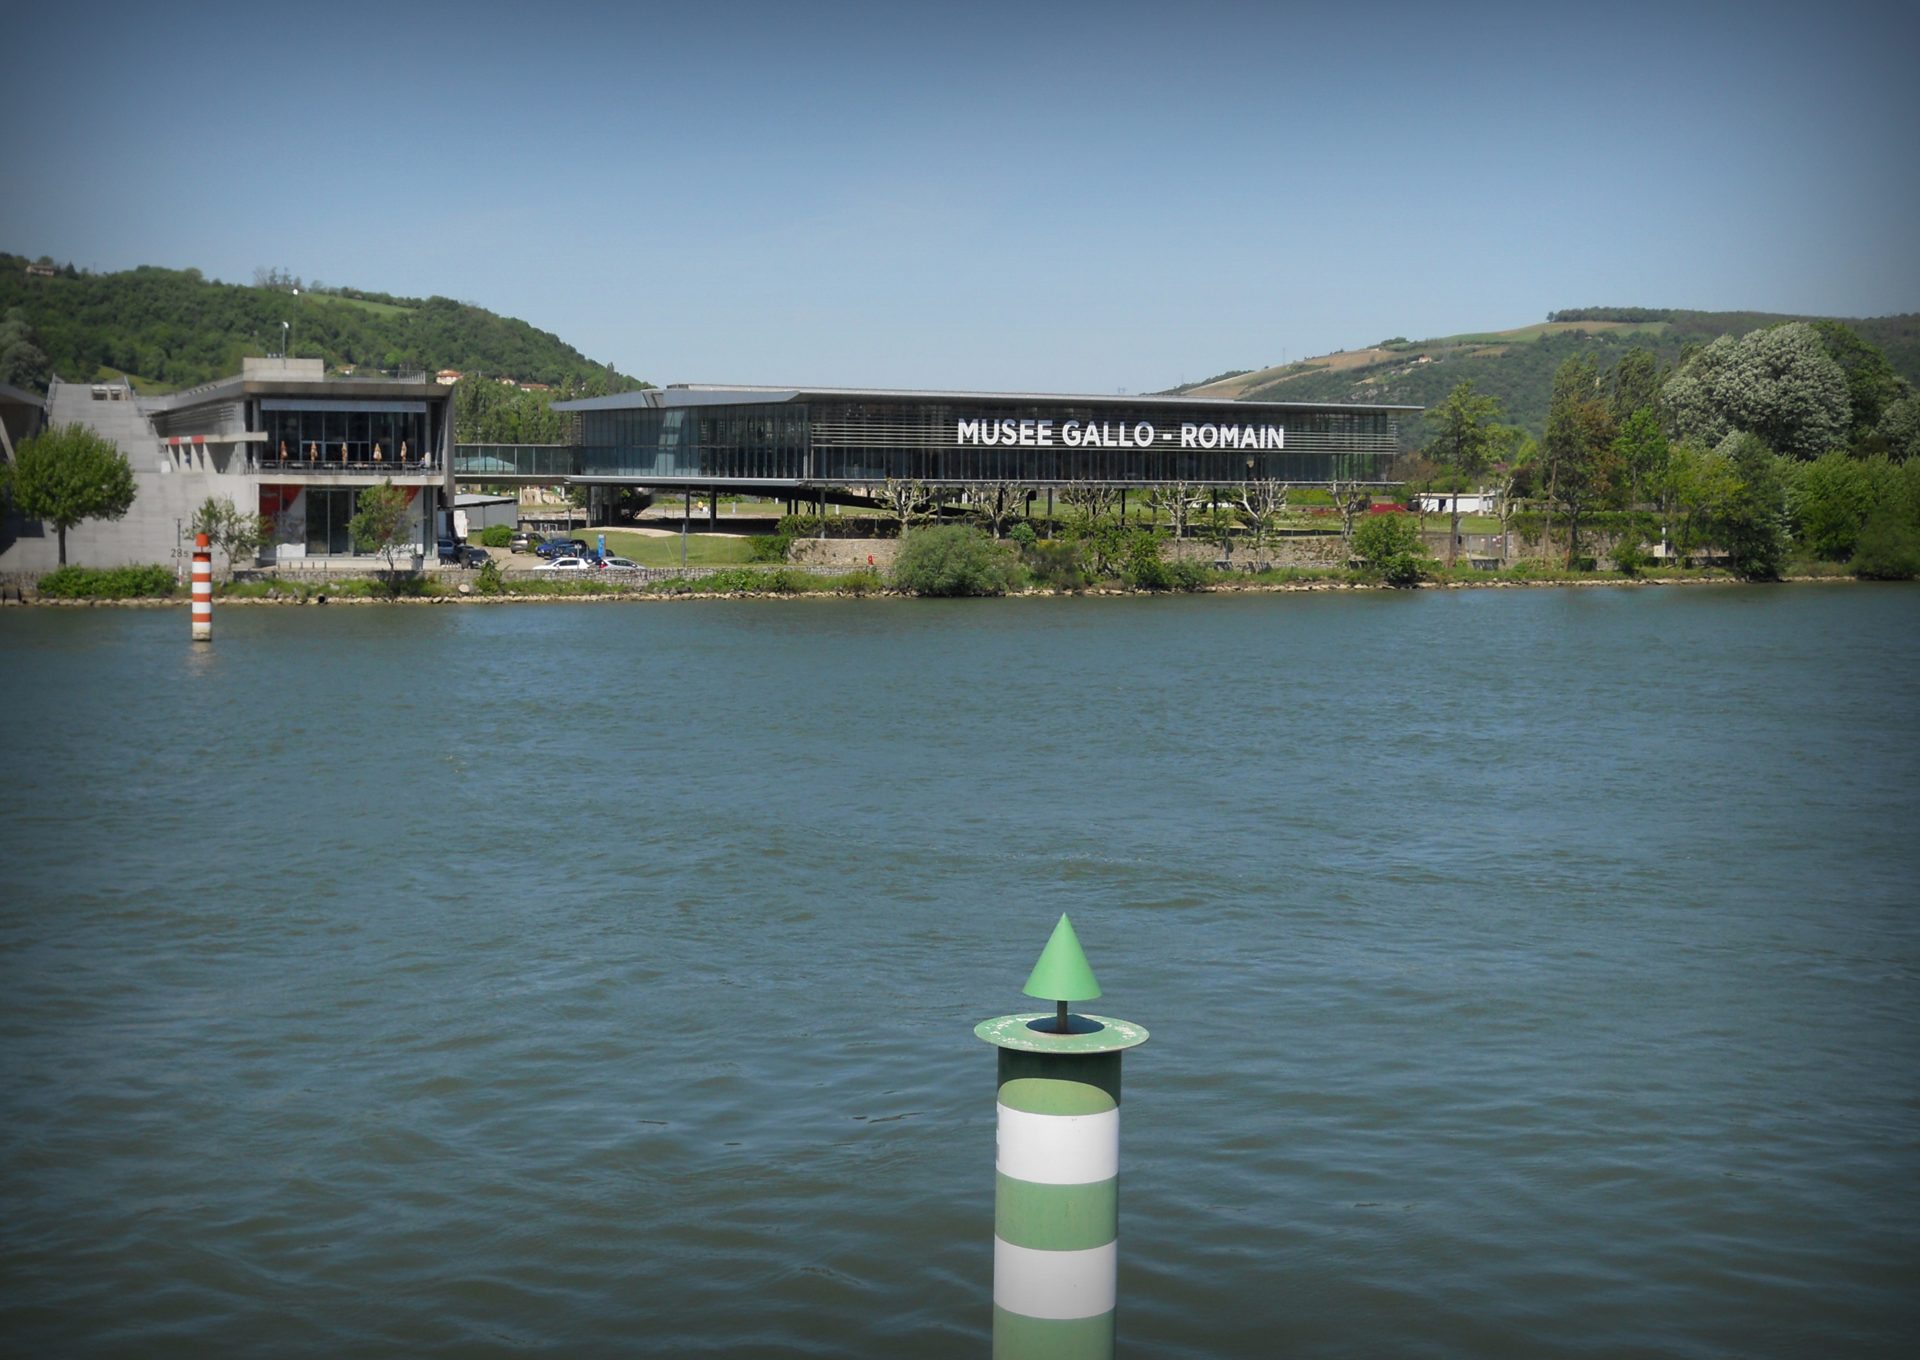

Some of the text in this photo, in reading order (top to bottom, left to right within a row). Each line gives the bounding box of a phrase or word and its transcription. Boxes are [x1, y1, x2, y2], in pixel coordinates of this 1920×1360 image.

[957, 418, 1053, 446] MUSEE
[1062, 420, 1155, 448] GALLO
[1180, 422, 1285, 449] ROMAIN
